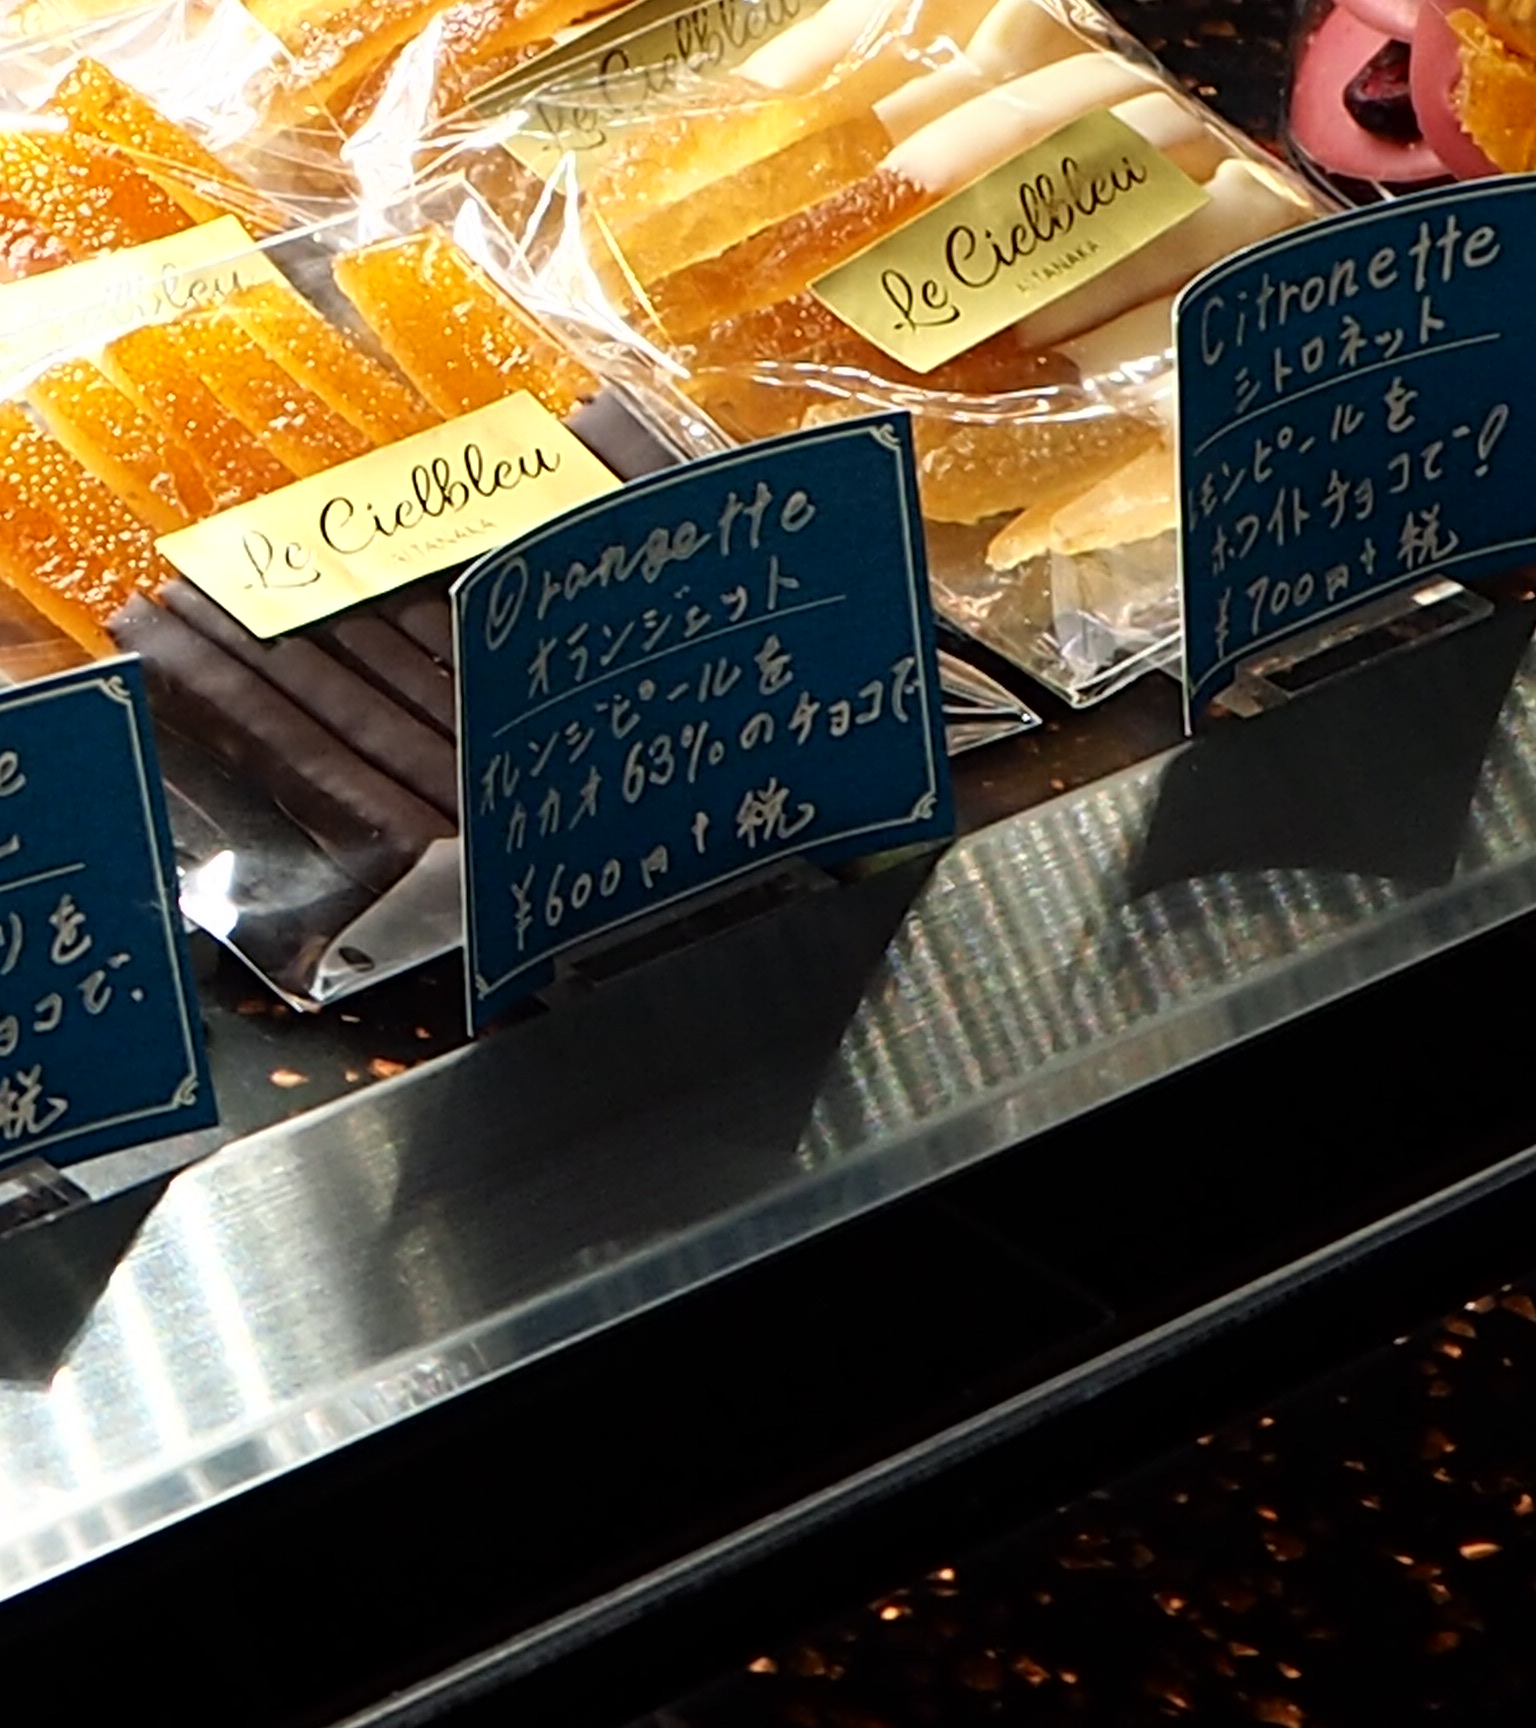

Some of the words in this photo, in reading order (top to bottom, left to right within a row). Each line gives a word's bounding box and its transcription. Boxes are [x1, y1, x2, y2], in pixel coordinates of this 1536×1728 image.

[1201, 214, 1501, 365] Citronette
[1235, 297, 1446, 413] シトロネット
[485, 482, 816, 650] Orangette
